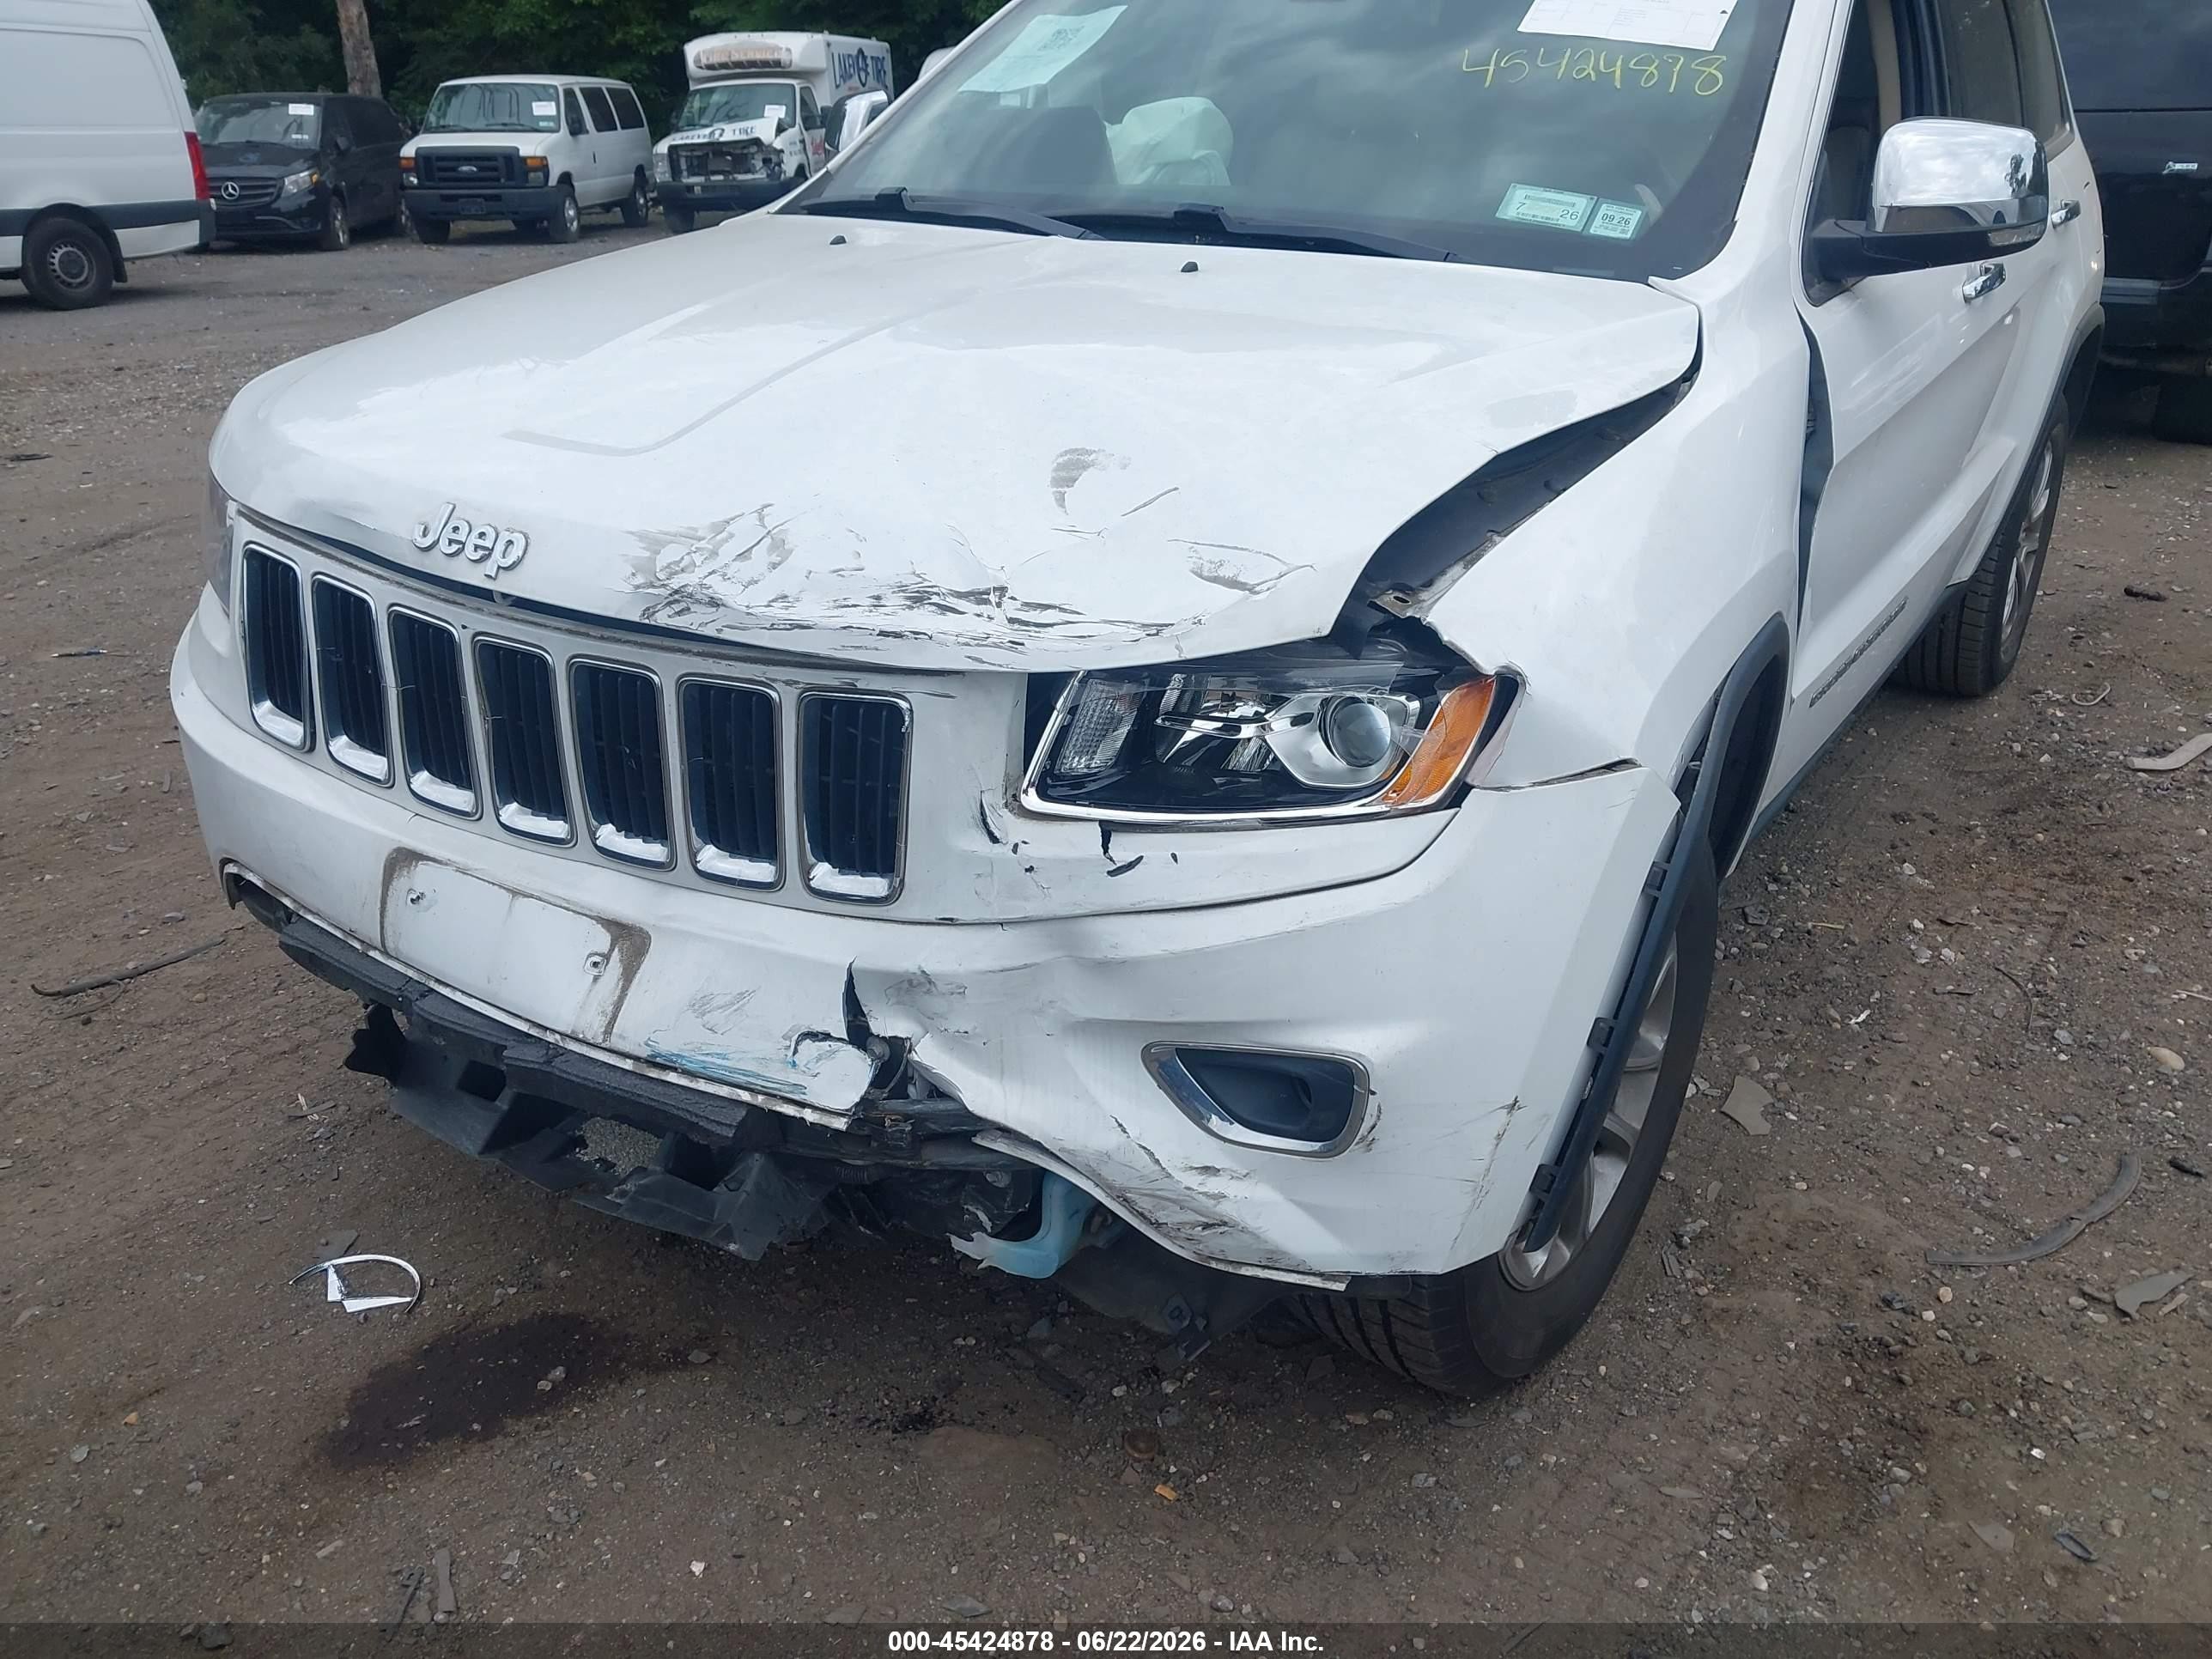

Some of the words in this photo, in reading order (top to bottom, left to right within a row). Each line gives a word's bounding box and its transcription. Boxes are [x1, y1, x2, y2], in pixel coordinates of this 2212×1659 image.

[1462, 48, 1727, 96] 45424878
[1516, 202, 1526, 210] 7
[1559, 209, 1579, 221] 26
[1617, 216, 1632, 226] 26
[412, 501, 530, 580] Jeep
